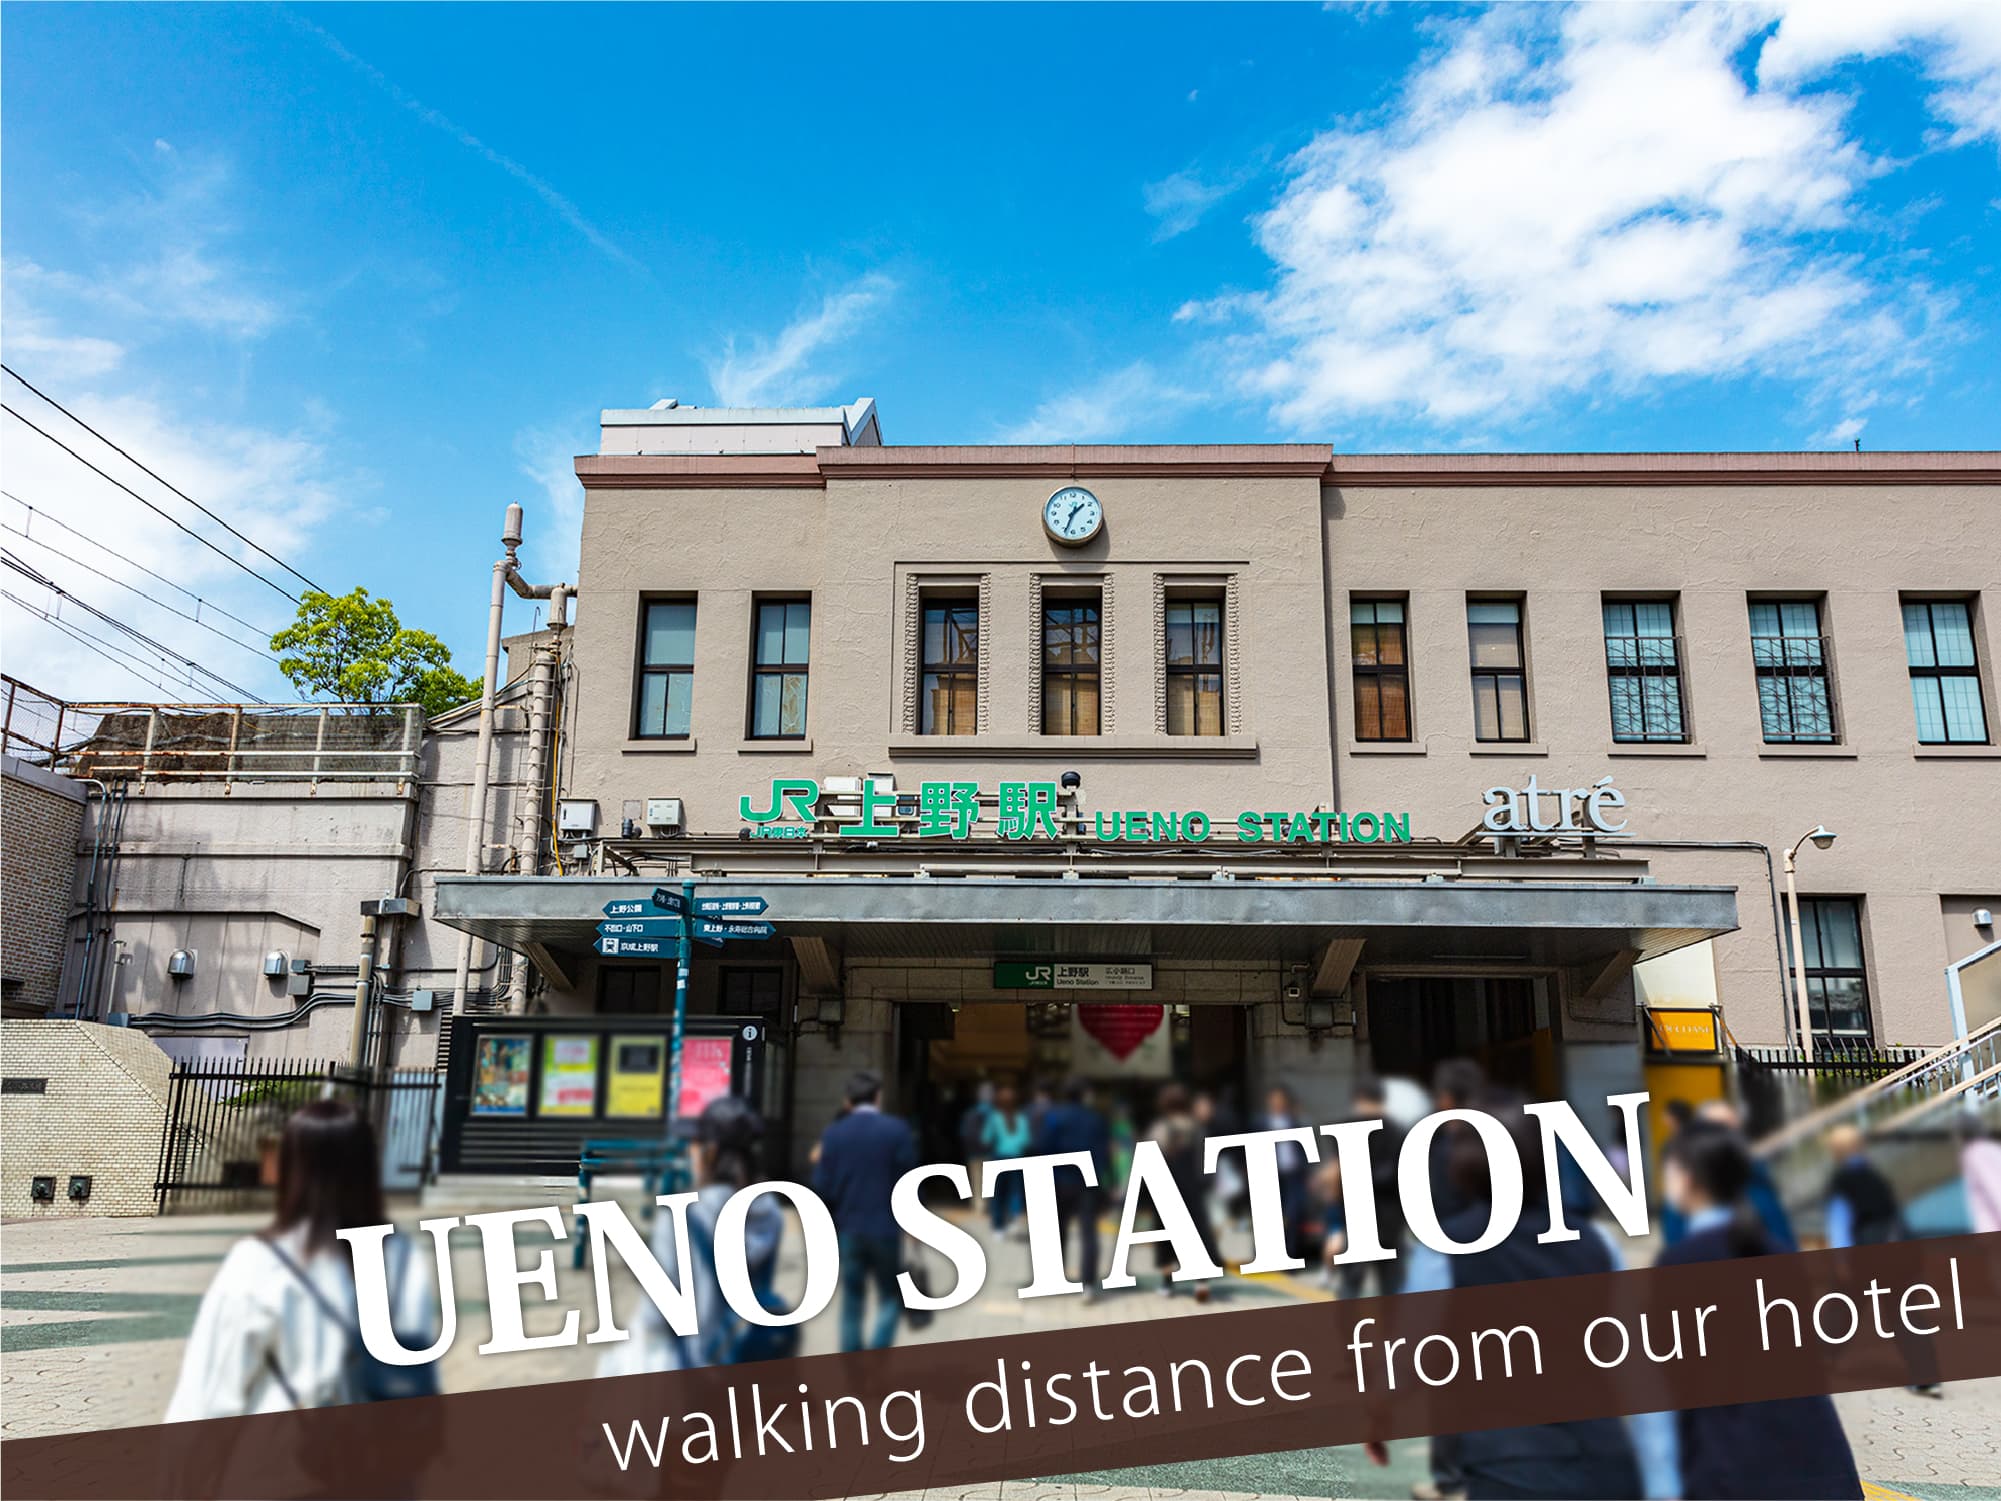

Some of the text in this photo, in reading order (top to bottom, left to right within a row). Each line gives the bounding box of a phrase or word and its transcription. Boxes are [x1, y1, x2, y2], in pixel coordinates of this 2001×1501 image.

[739, 778, 1058, 841] JR 上野駅
[1483, 774, 1628, 832] atré
[1095, 811, 1412, 844] UENO STATION
[1025, 966, 1051, 981] JR
[1057, 967, 1090, 978] 上野駅
